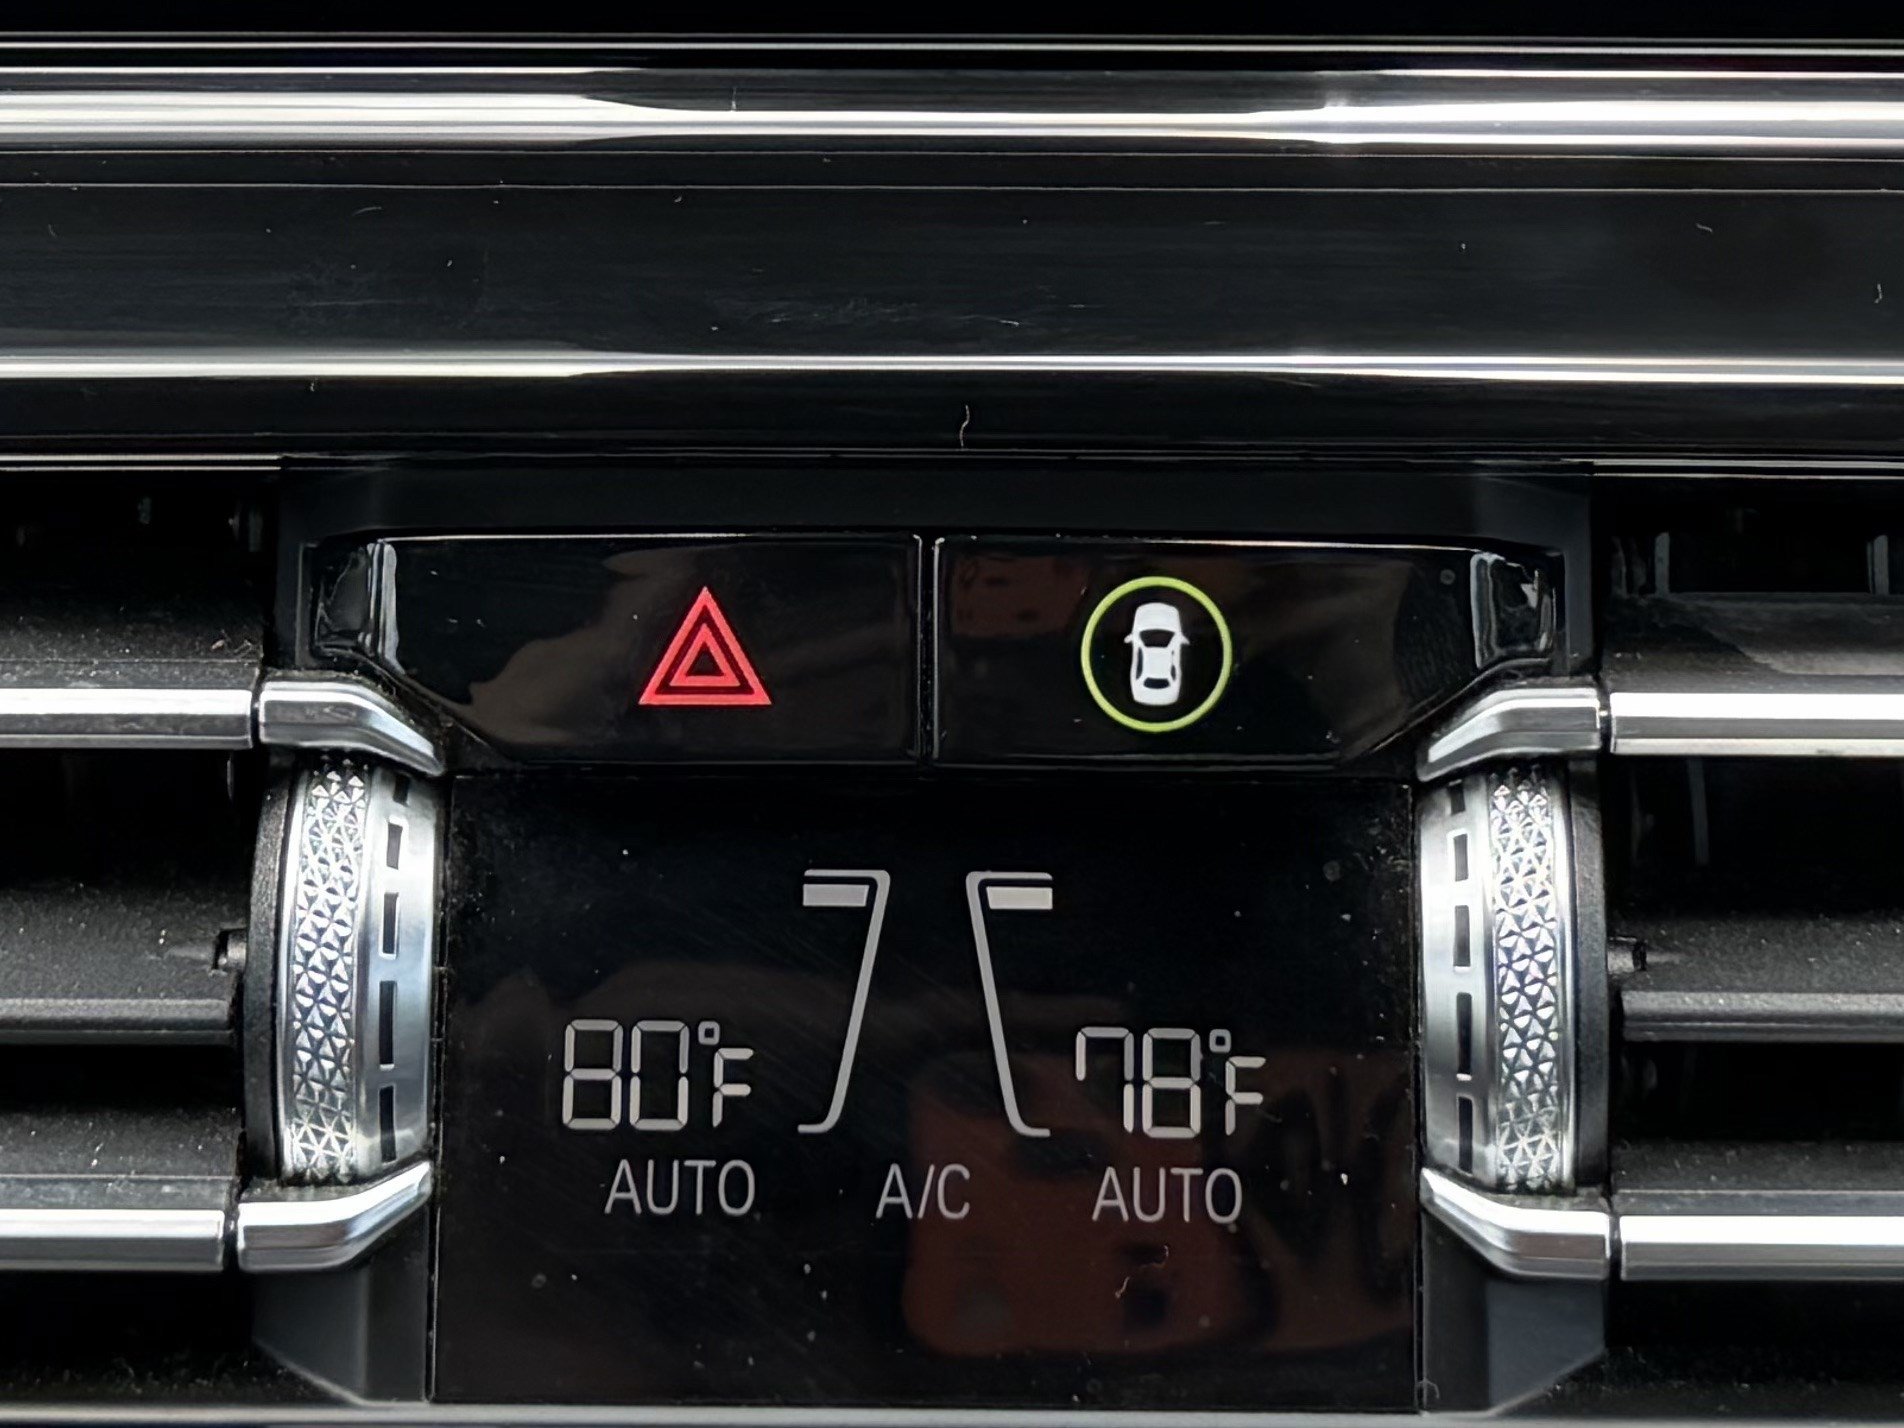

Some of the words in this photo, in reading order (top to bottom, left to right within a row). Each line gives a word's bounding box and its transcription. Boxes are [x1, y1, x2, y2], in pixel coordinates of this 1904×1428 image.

[561, 1019, 755, 1132] 80°F
[1075, 1026, 1267, 1139] 78°F
[604, 1158, 756, 1217] AUTO
[875, 1163, 971, 1221] A/C
[1091, 1166, 1244, 1224] AUTO
